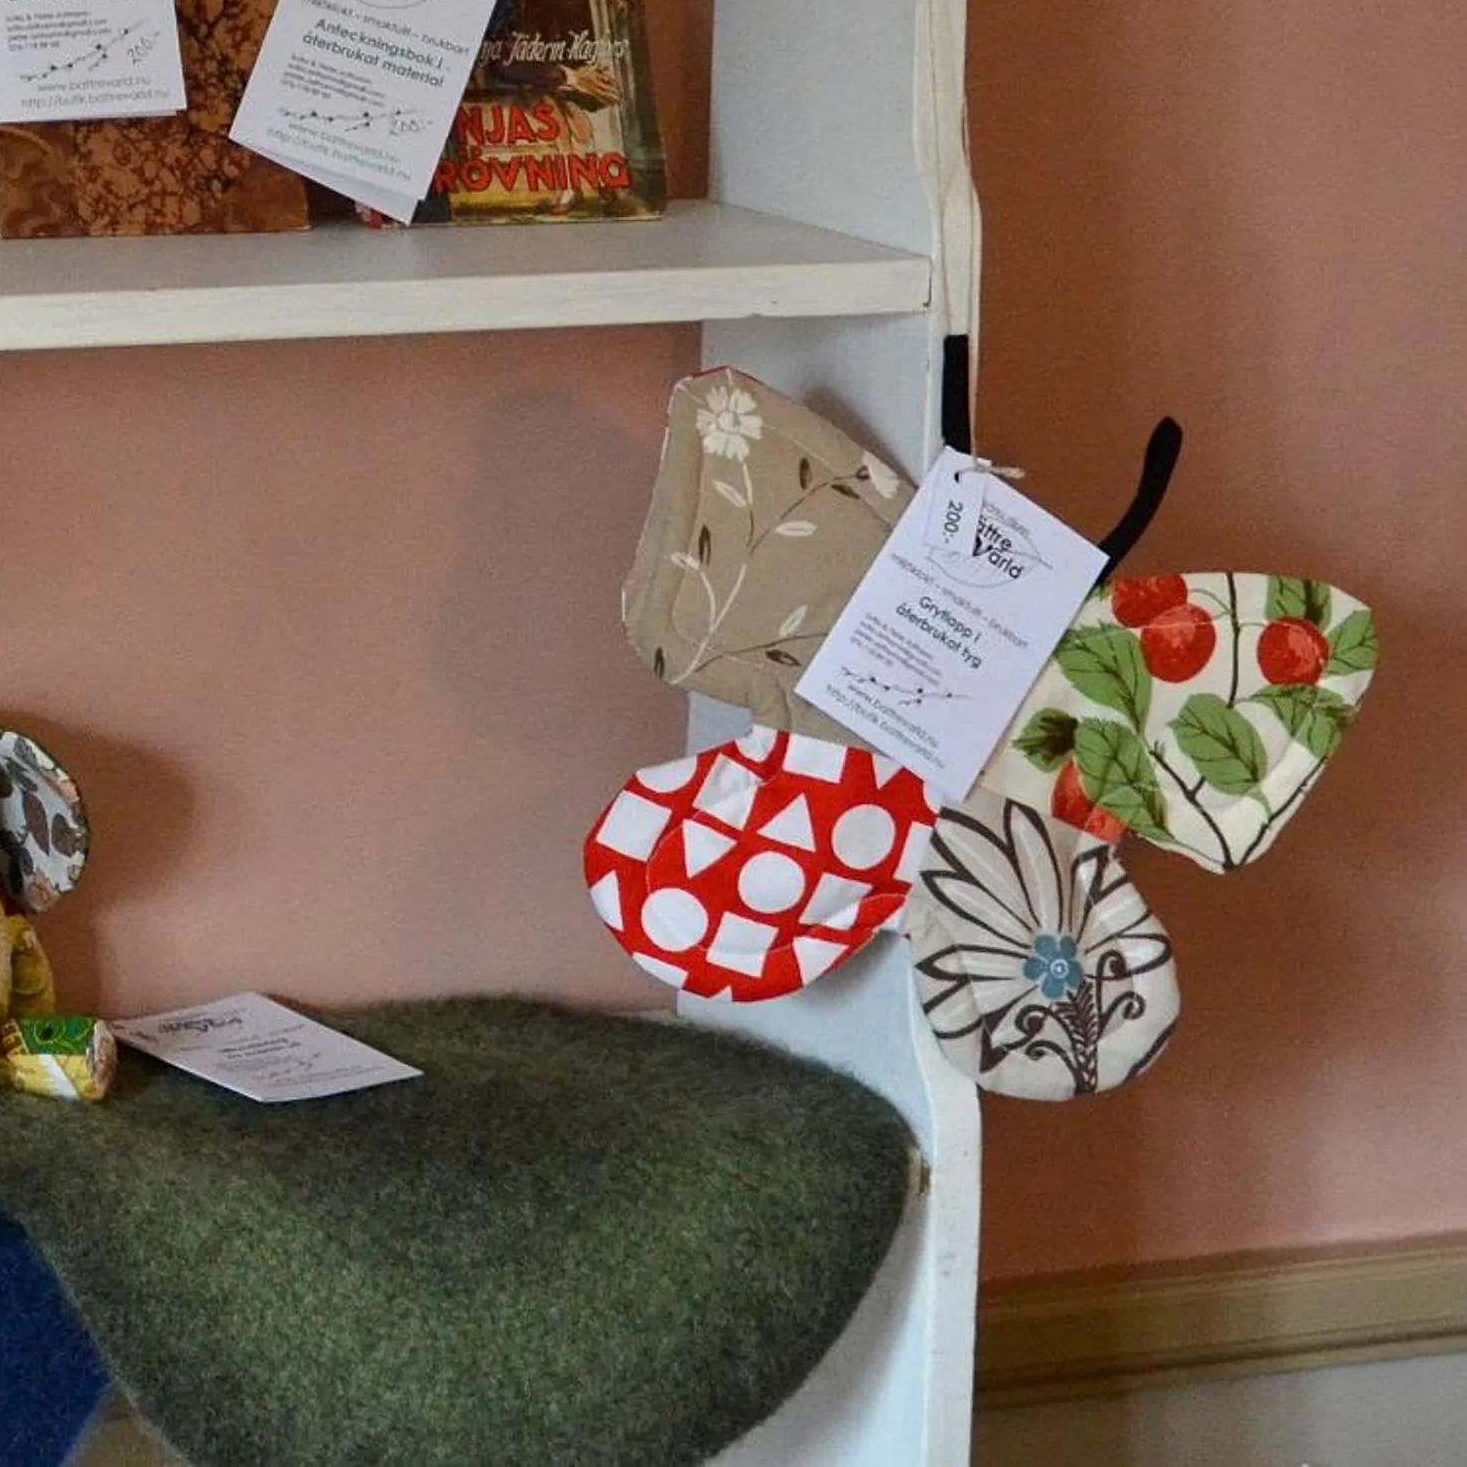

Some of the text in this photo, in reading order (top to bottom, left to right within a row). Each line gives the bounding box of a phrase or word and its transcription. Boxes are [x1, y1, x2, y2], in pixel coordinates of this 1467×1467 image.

[302, 33, 381, 69] återbrukat
[382, 59, 445, 87] material
[314, 18, 435, 68] Anteckningsbok
[457, 100, 561, 146] NJAS
[972, 535, 1025, 579] Värld
[895, 603, 963, 652] återbrukat
[960, 647, 983, 670] tyg
[918, 595, 976, 640] Grytlapp
